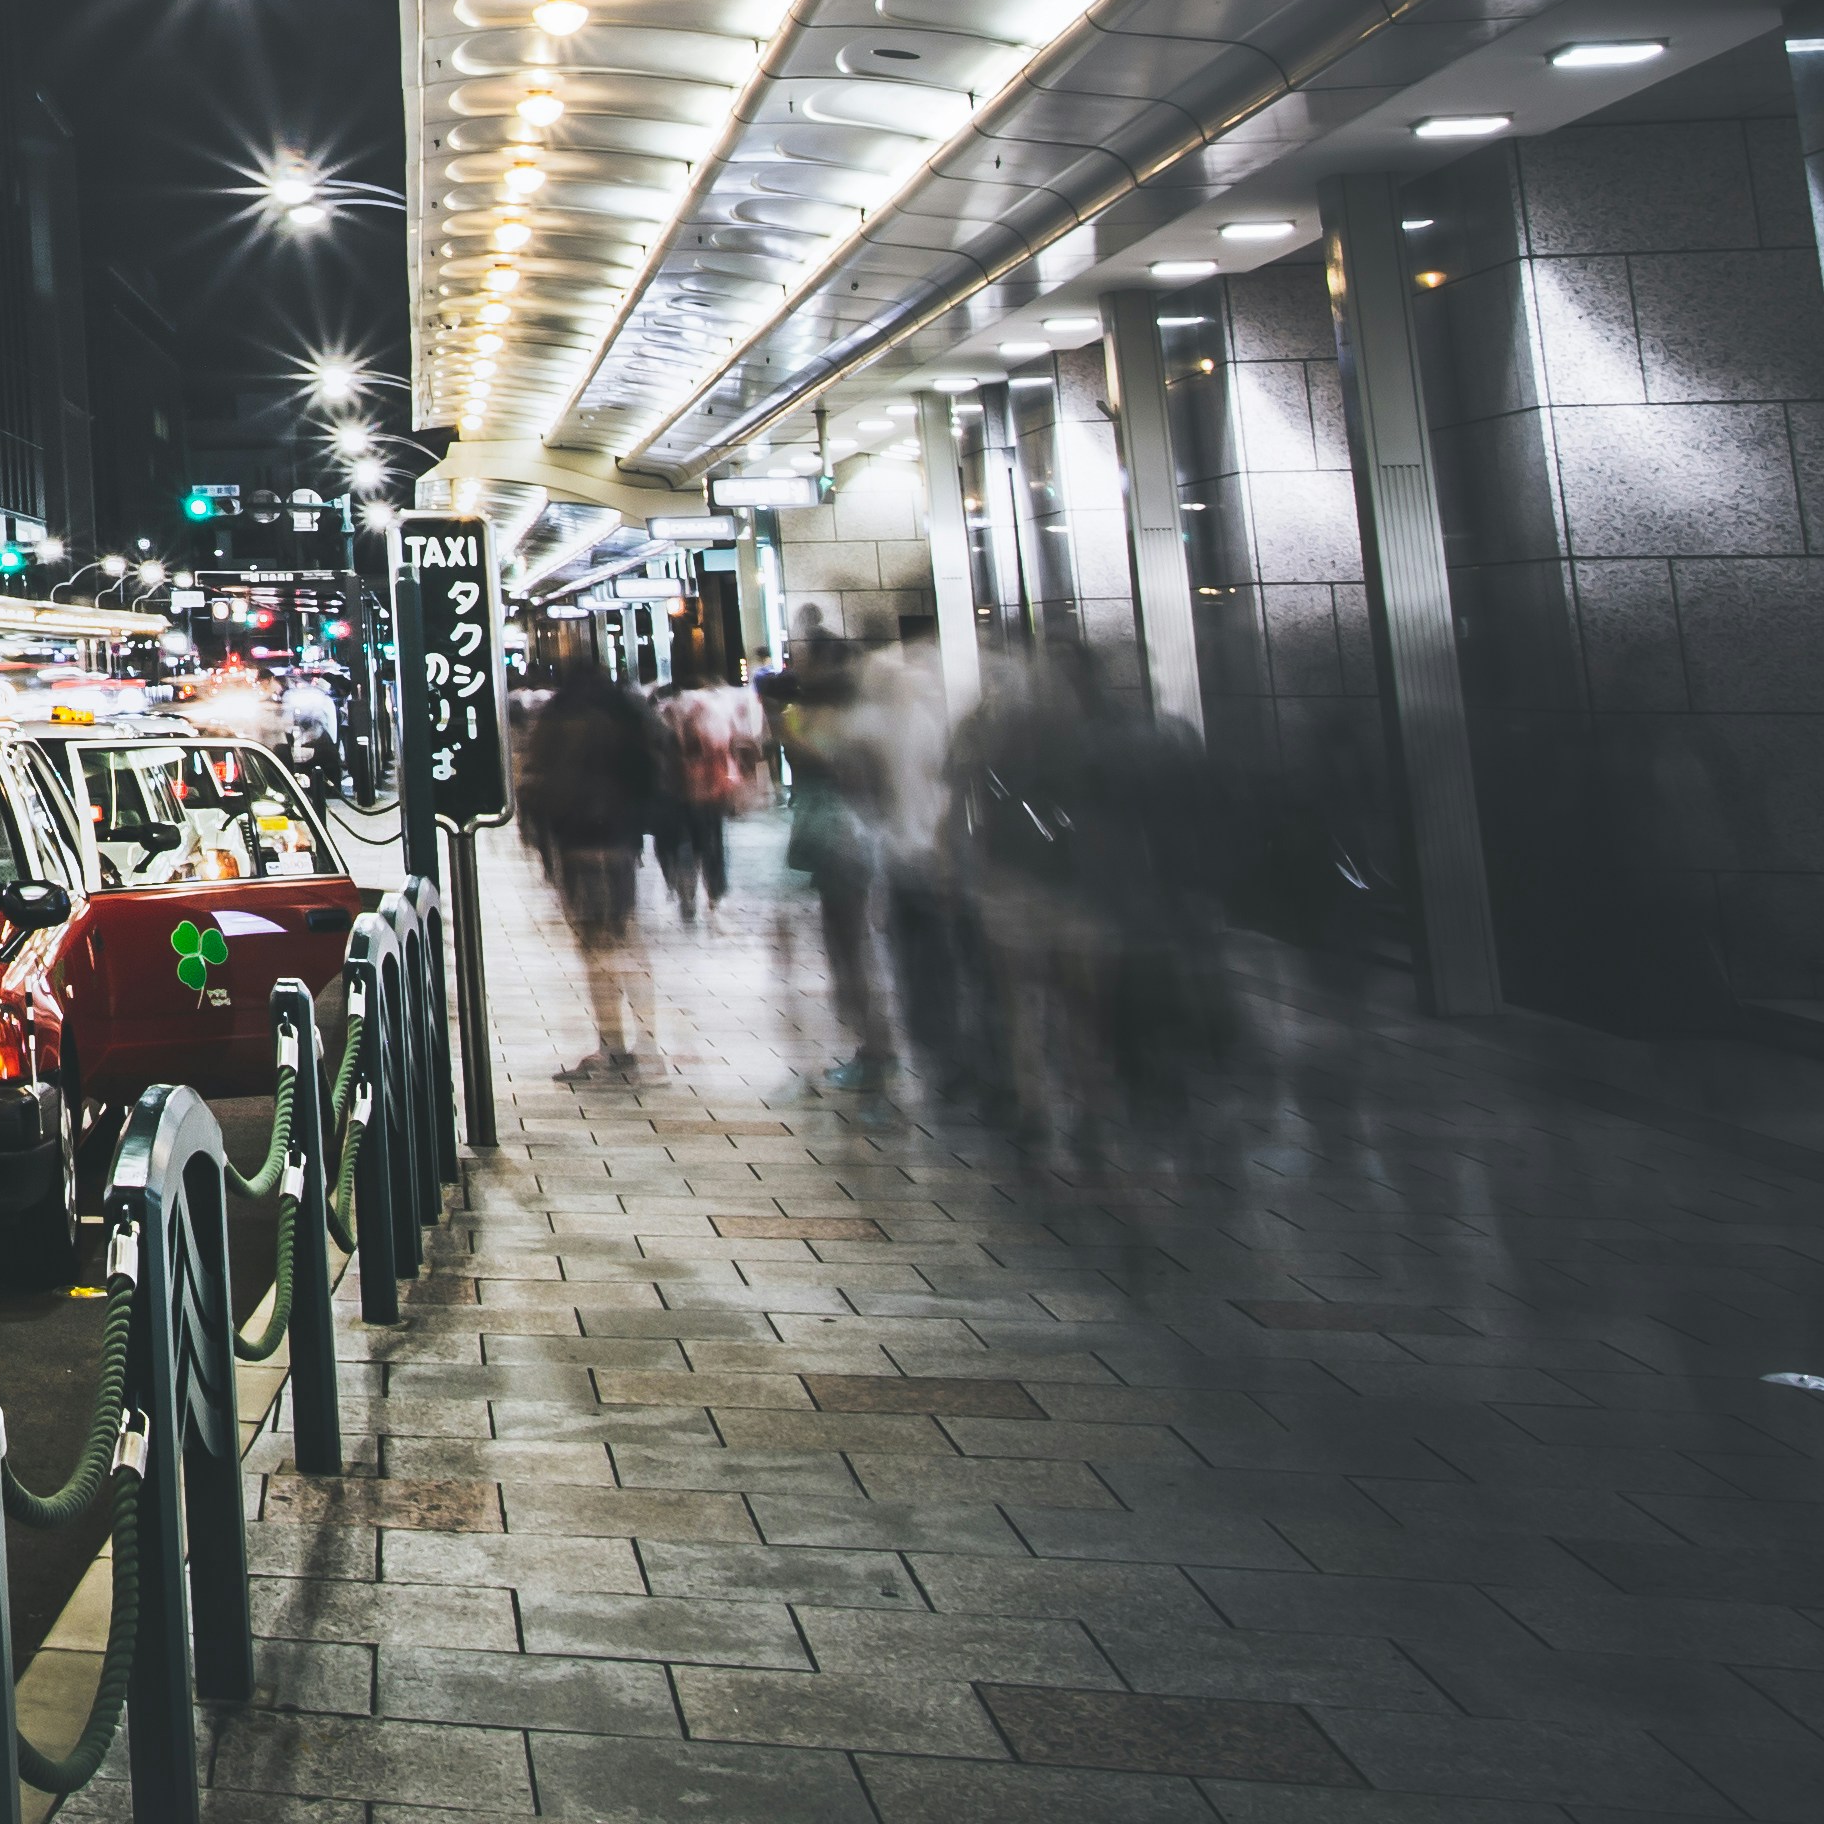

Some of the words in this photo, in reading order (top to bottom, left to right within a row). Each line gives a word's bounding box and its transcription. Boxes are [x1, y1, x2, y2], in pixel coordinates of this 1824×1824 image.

[404, 536, 478, 568] TAXI
[447, 580, 486, 740] タクシー
